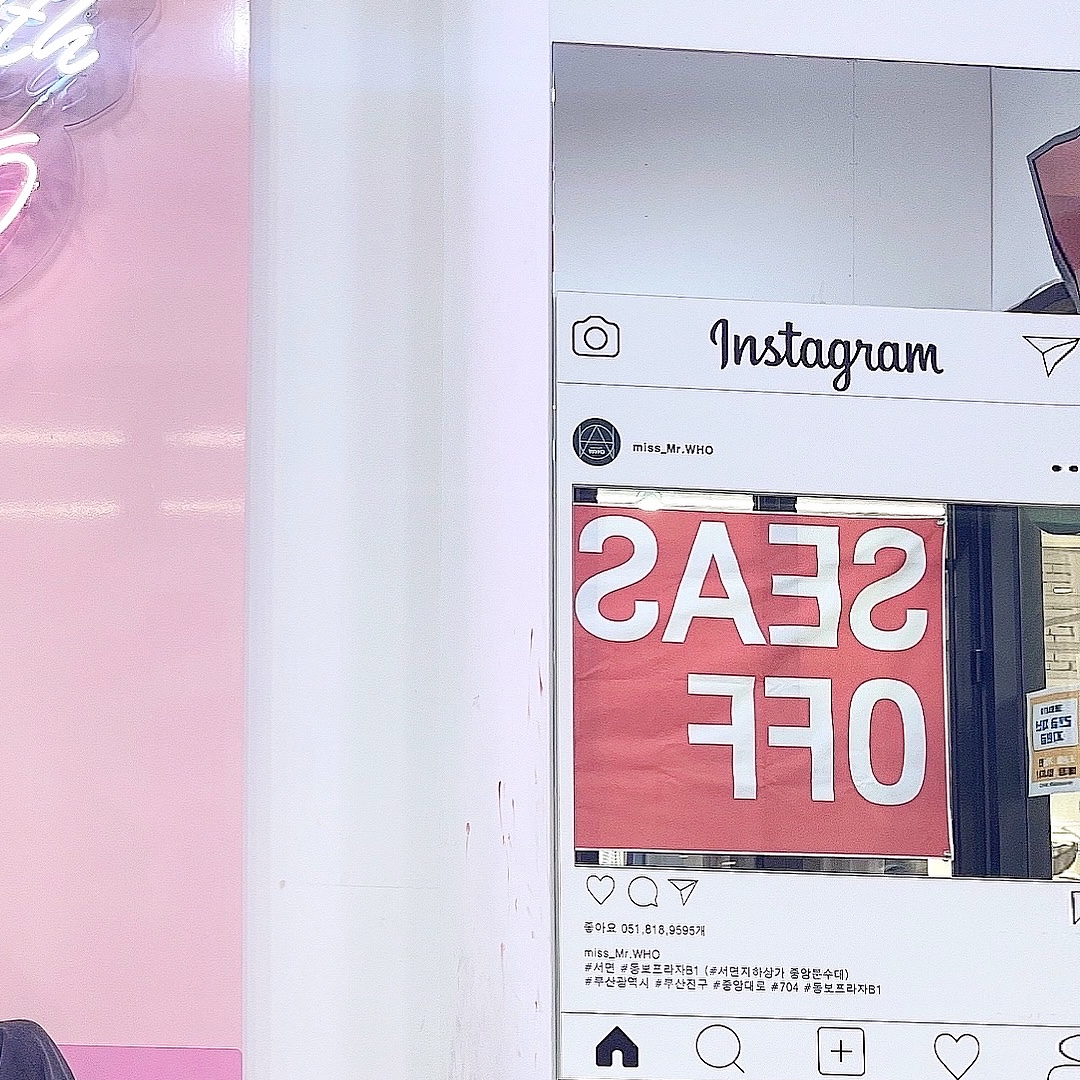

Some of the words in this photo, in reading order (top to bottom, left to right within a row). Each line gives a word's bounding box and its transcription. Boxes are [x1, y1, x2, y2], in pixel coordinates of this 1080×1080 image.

[710, 318, 945, 392] Instagram
[632, 442, 714, 455] miss_Mr.WHO
[583, 921, 617, 934] 좋아요
[584, 947, 661, 960] miss_Mr.WHO
[584, 962, 615, 974] #서면
[584, 976, 649, 989] #부산광역시
[655, 978, 708, 991] #부산진구
[712, 979, 766, 992] #중앙대로
[771, 981, 799, 993] #704
